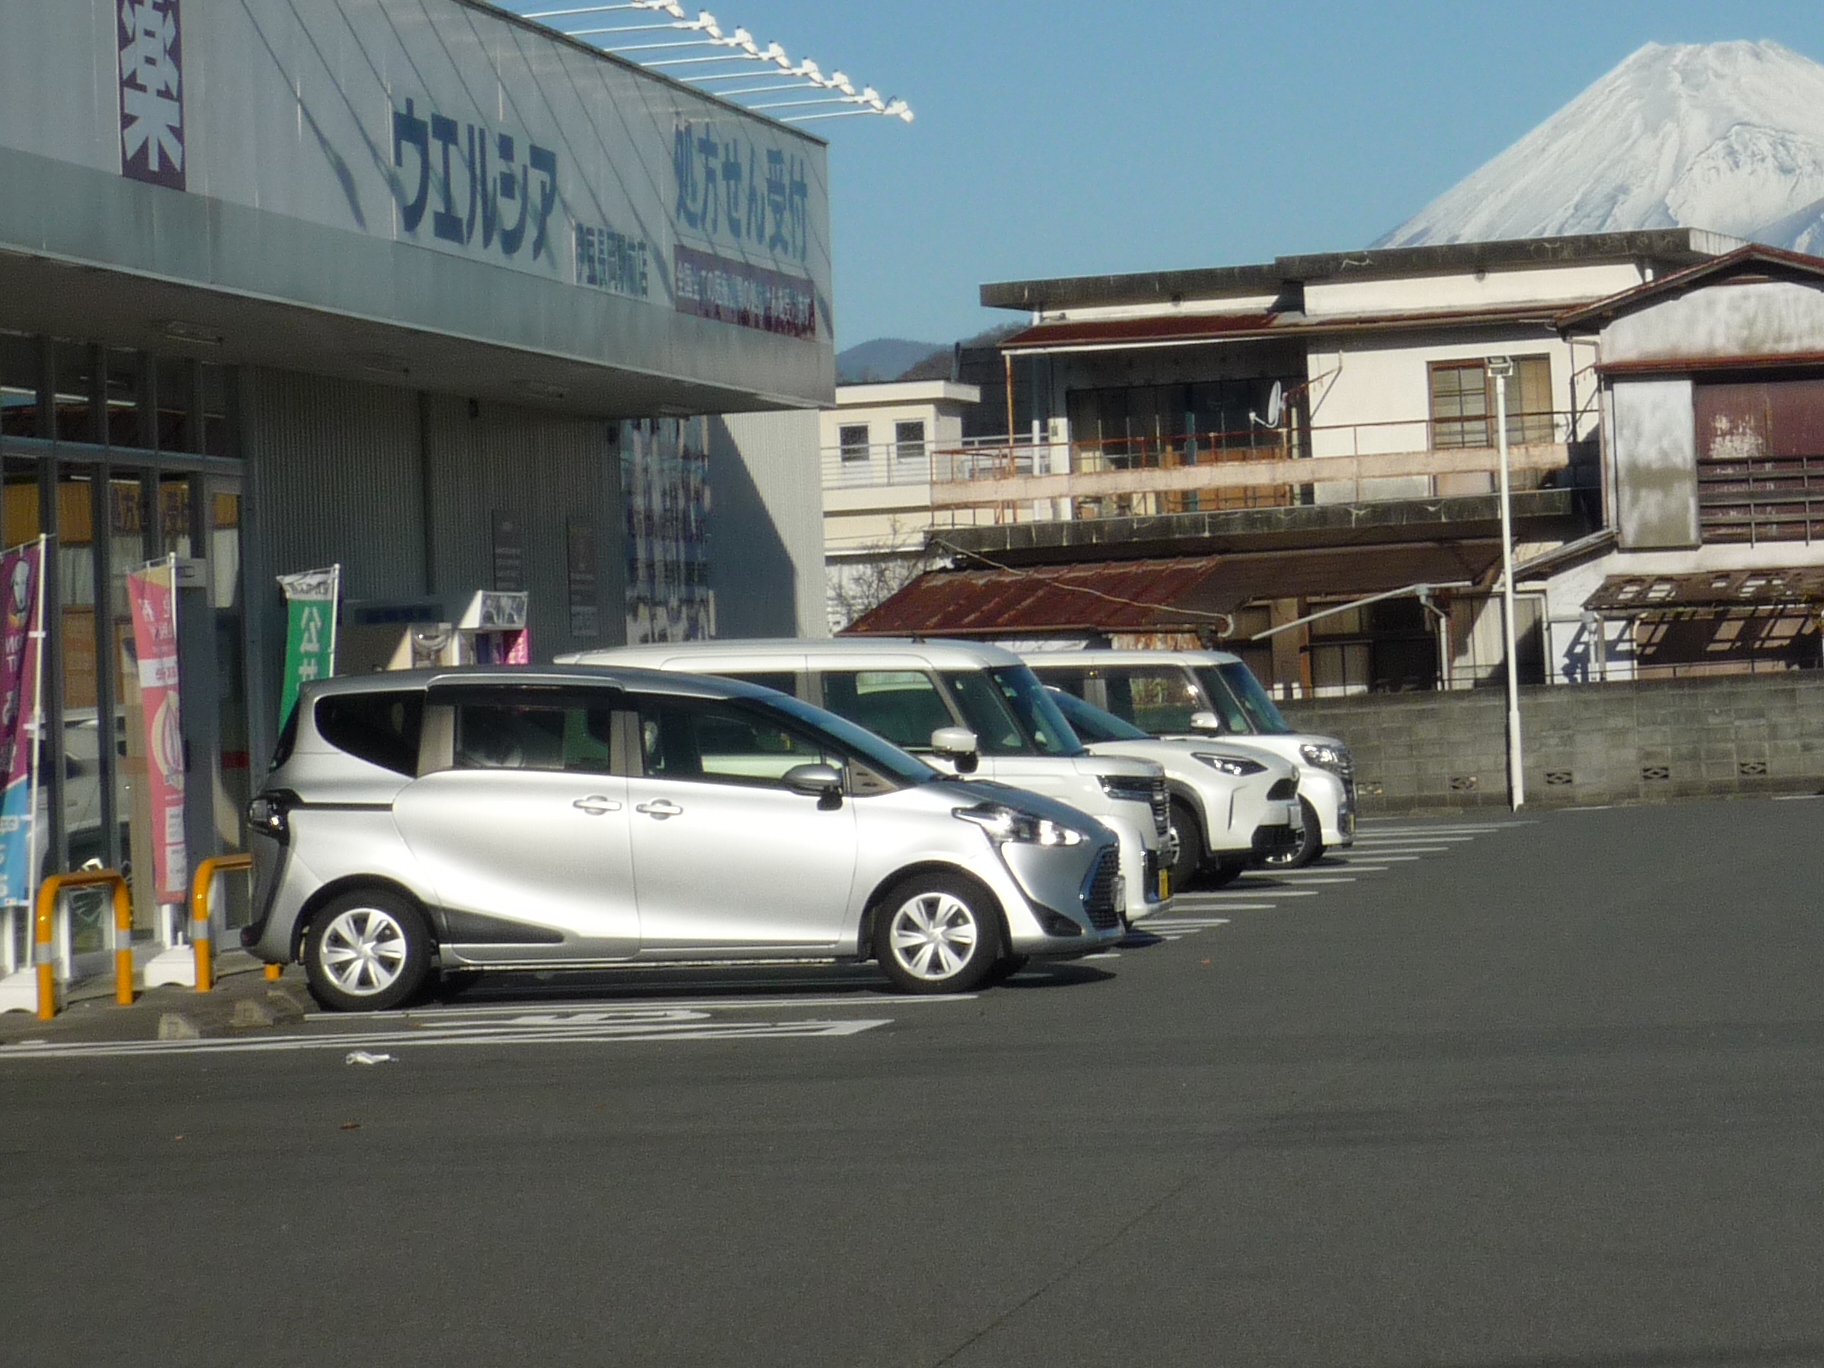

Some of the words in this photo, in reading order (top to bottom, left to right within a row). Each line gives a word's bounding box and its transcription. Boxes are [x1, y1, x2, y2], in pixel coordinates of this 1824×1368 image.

[393, 97, 557, 261] ウエルシア
[673, 119, 808, 264] 処方せん受付
